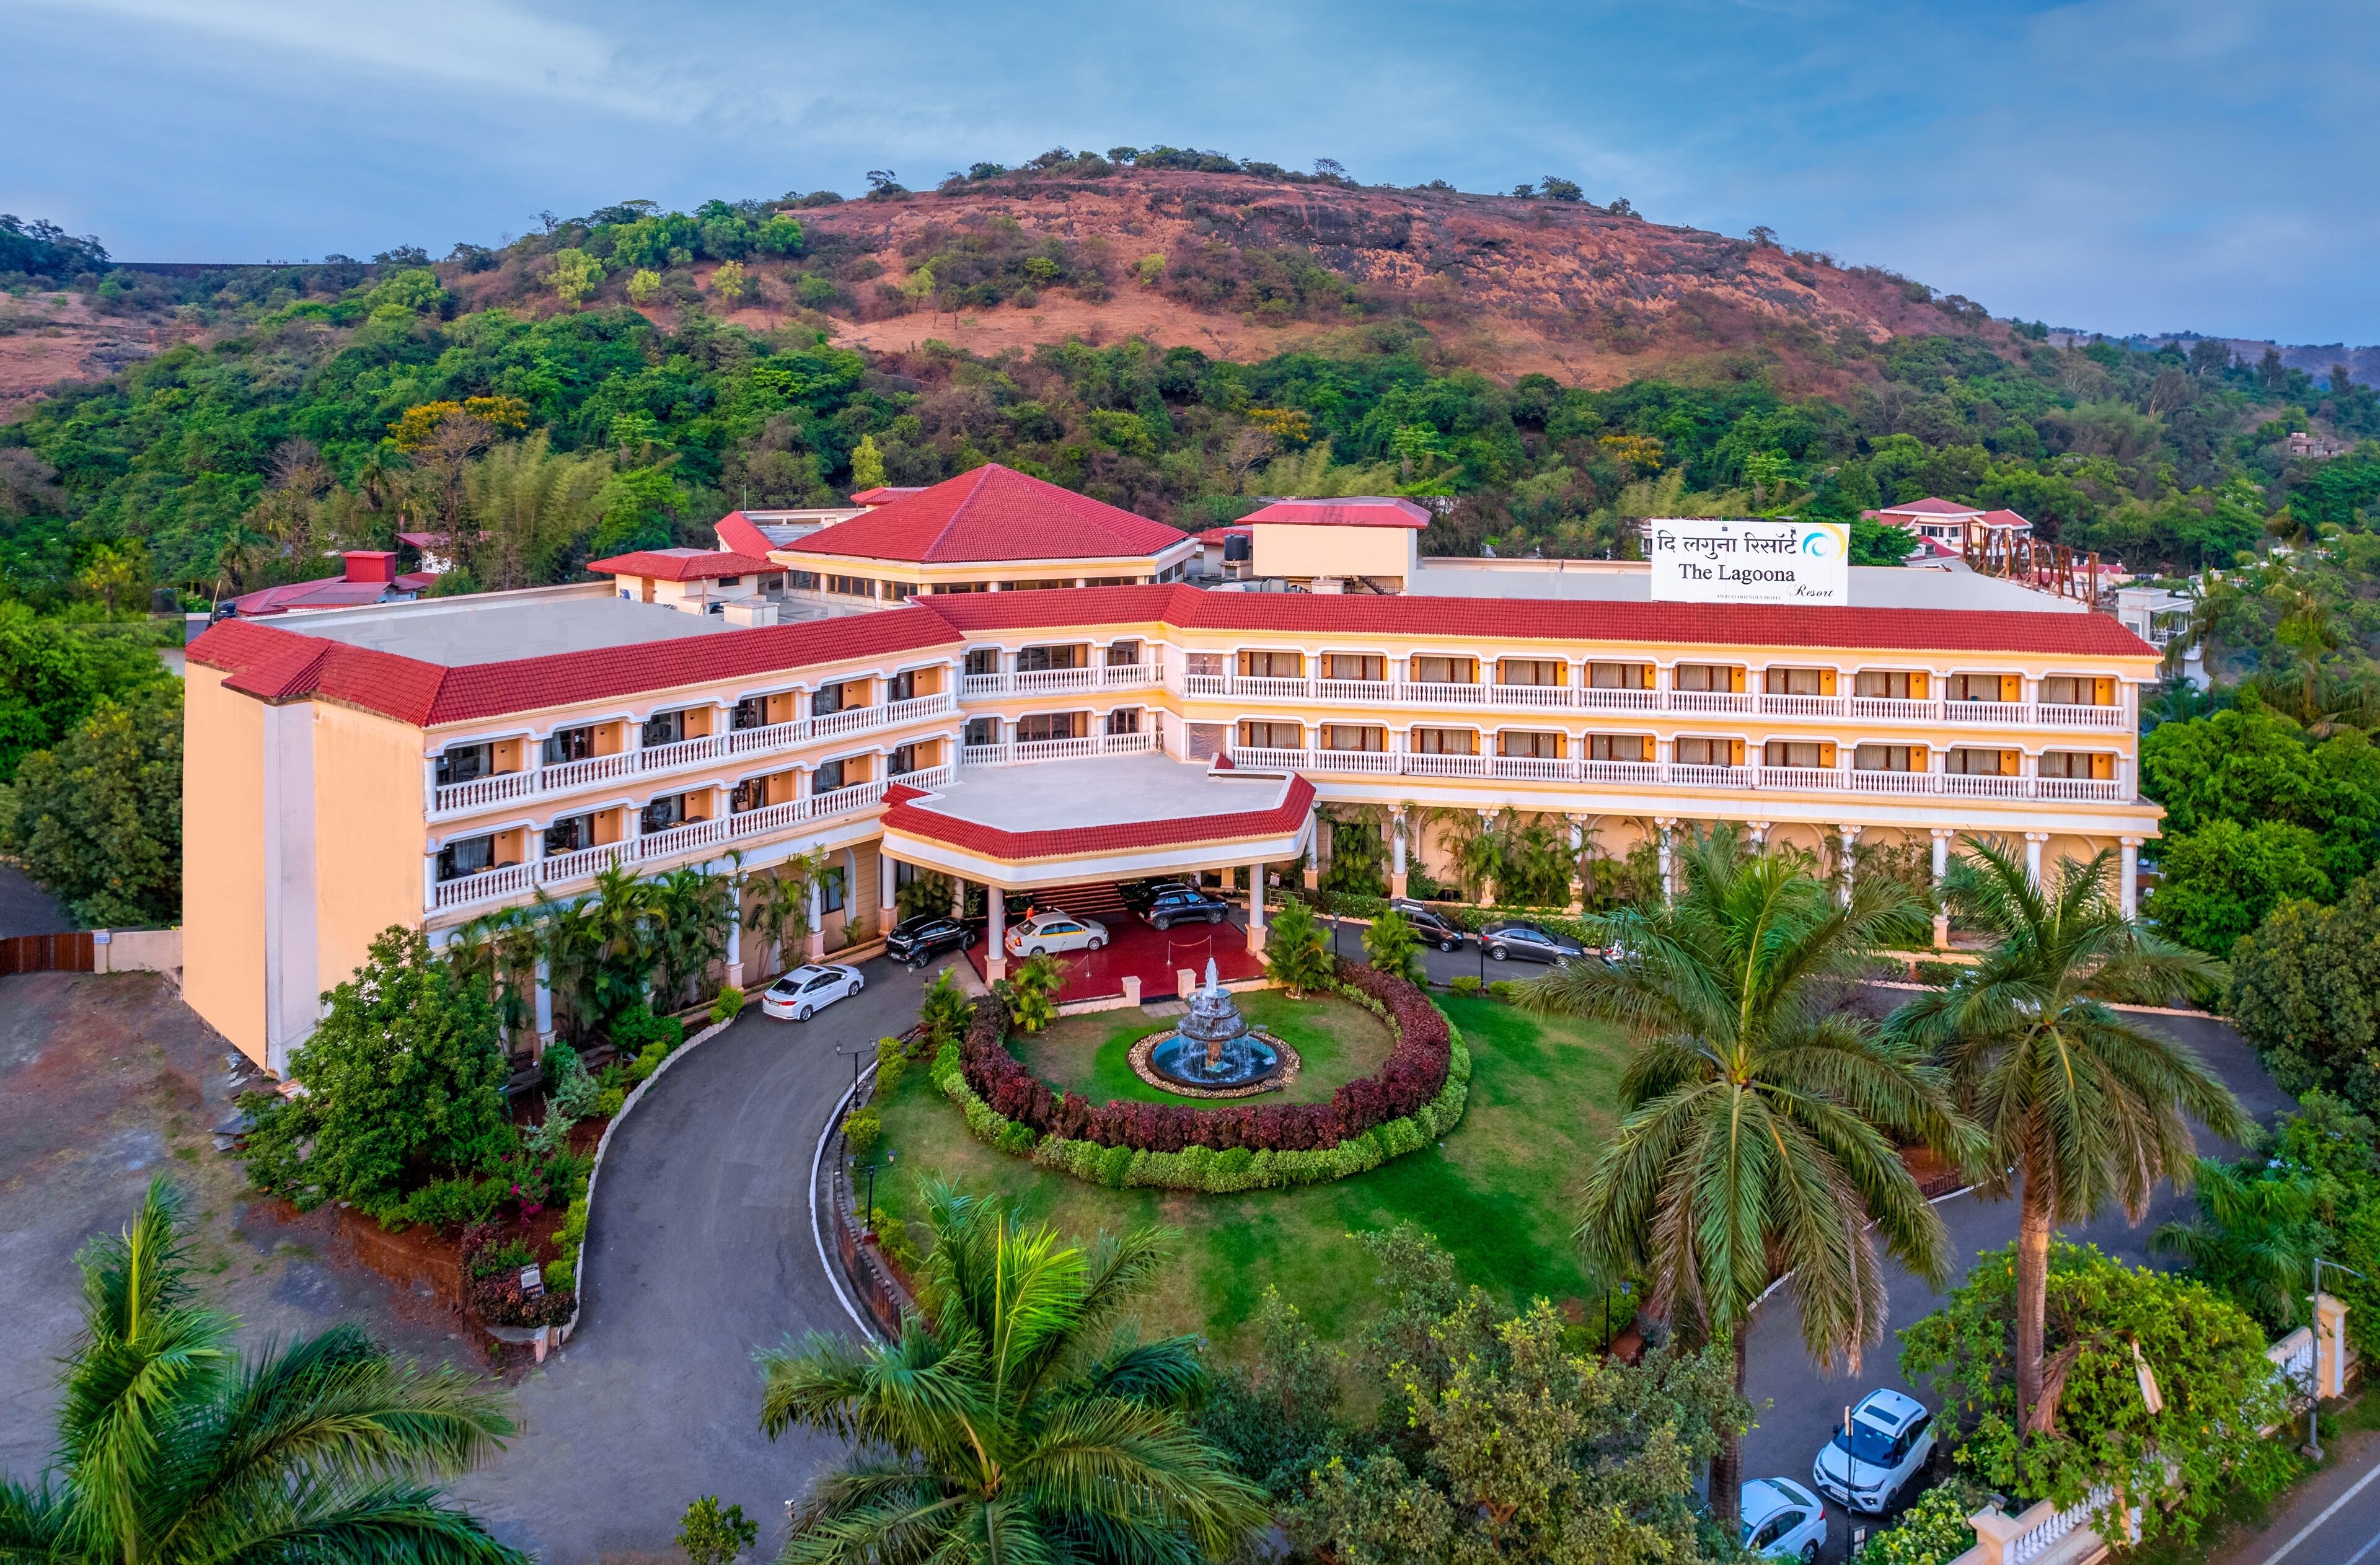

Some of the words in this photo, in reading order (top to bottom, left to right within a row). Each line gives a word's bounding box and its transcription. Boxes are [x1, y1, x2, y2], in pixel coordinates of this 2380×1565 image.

[1656, 529, 1676, 553] दि
[1682, 537, 1737, 560] लगुना
[1678, 563, 1712, 580] The
[1718, 565, 1796, 585] Lagoona
[1787, 583, 1834, 597] Resort
